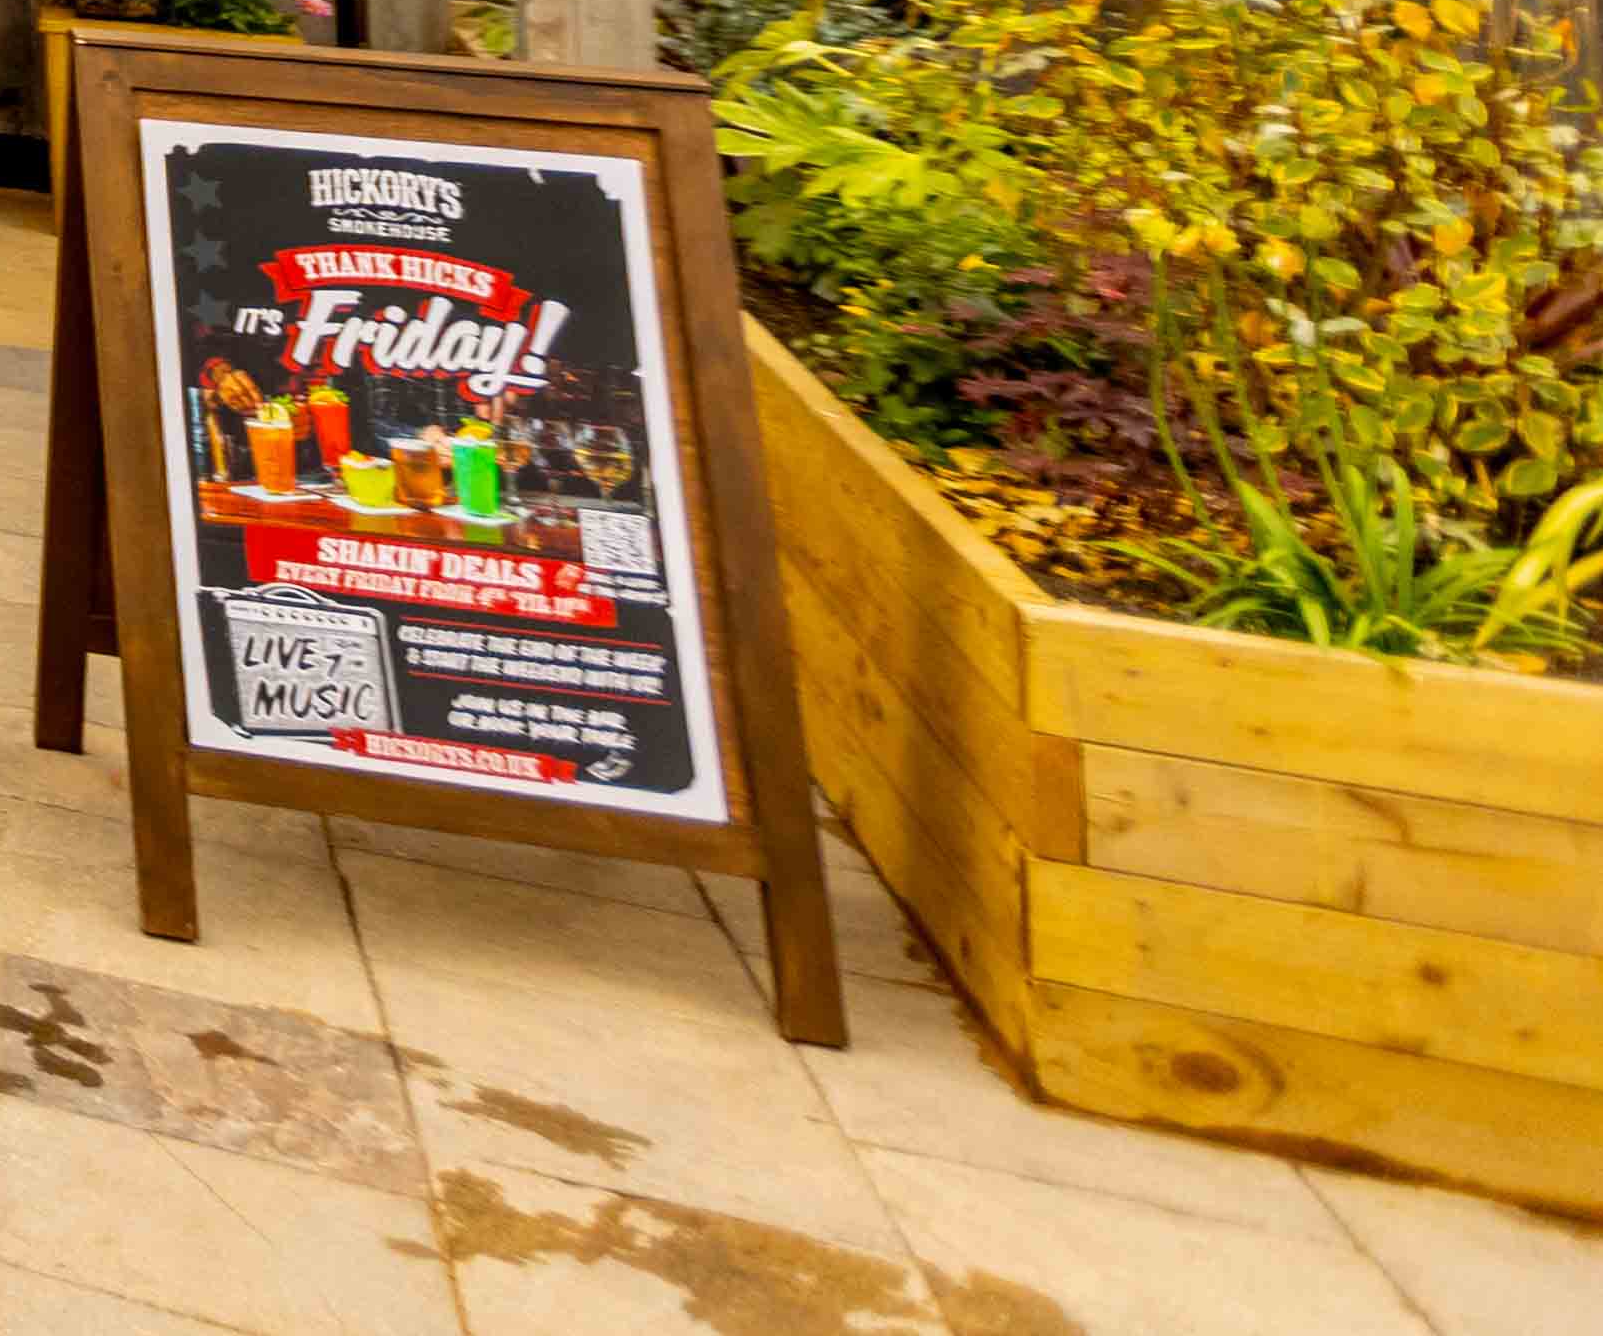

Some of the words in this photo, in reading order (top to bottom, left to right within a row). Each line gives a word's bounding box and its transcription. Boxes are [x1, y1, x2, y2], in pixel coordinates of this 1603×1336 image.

[308, 168, 464, 220] HICKORY'S
[295, 251, 396, 280] THANK
[399, 254, 496, 298] HICKS
[233, 306, 286, 337] IT'S
[291, 289, 571, 397] Friday!
[441, 551, 544, 590] DEALS
[244, 635, 317, 670] LIVE
[253, 680, 374, 721] MUSIC
